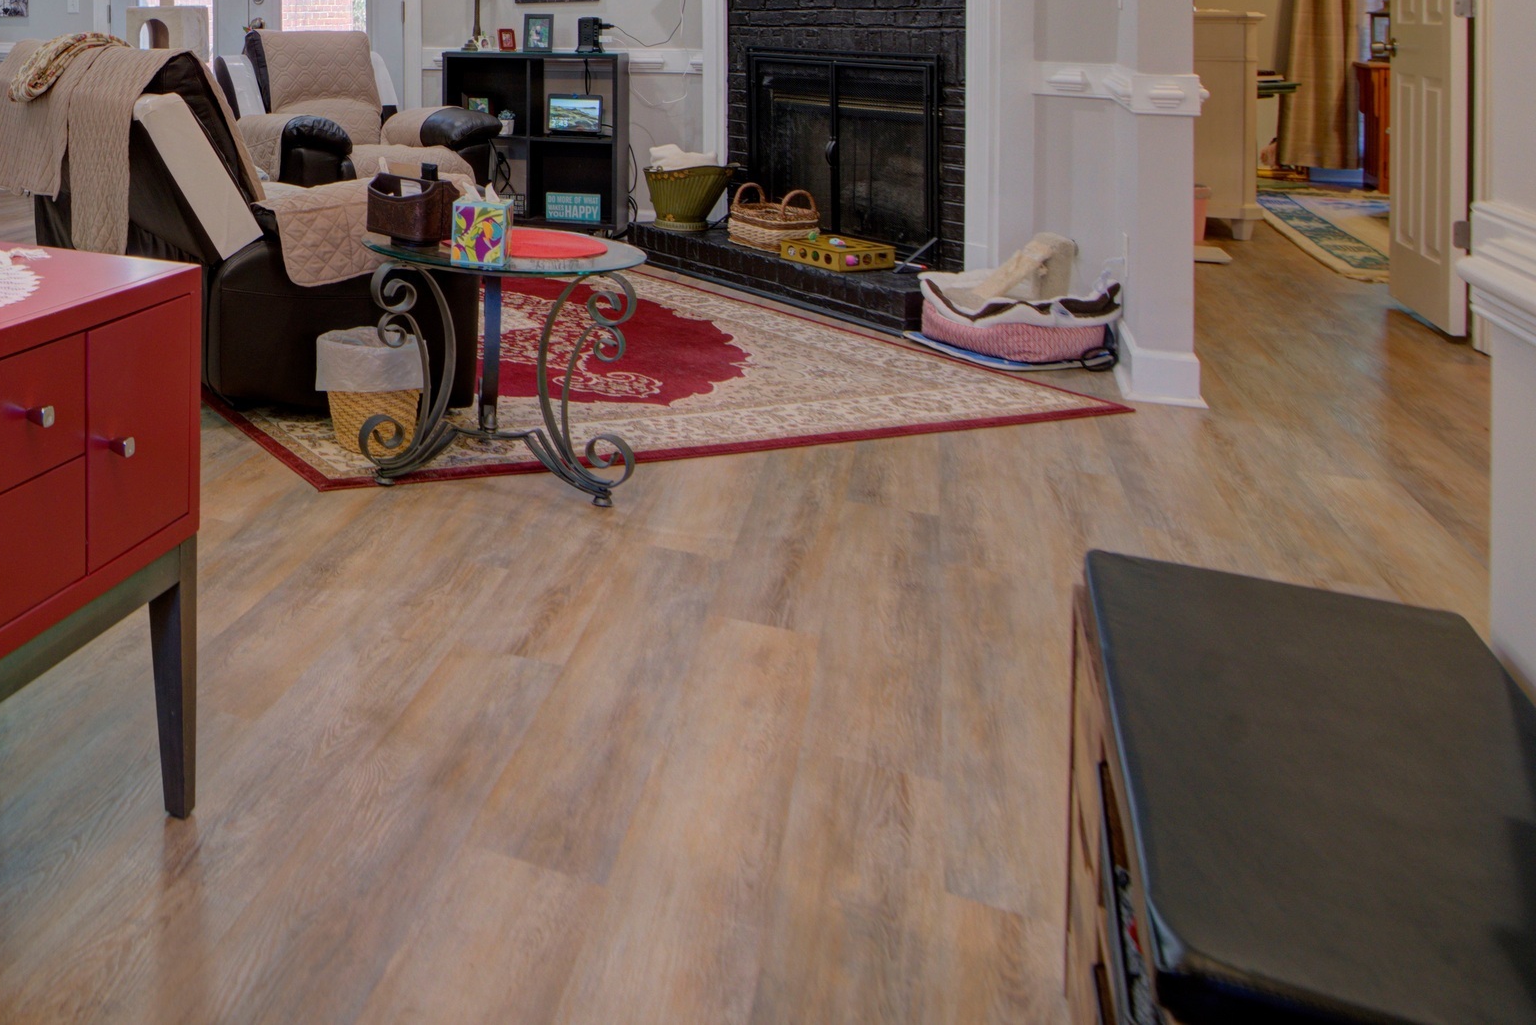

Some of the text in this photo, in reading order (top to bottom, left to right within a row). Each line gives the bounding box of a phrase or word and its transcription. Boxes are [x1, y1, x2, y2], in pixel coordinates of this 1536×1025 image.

[548, 195, 556, 203] DO
[574, 196, 581, 204] OF
[584, 197, 598, 205] WHAT
[565, 205, 598, 219] HAPPY
